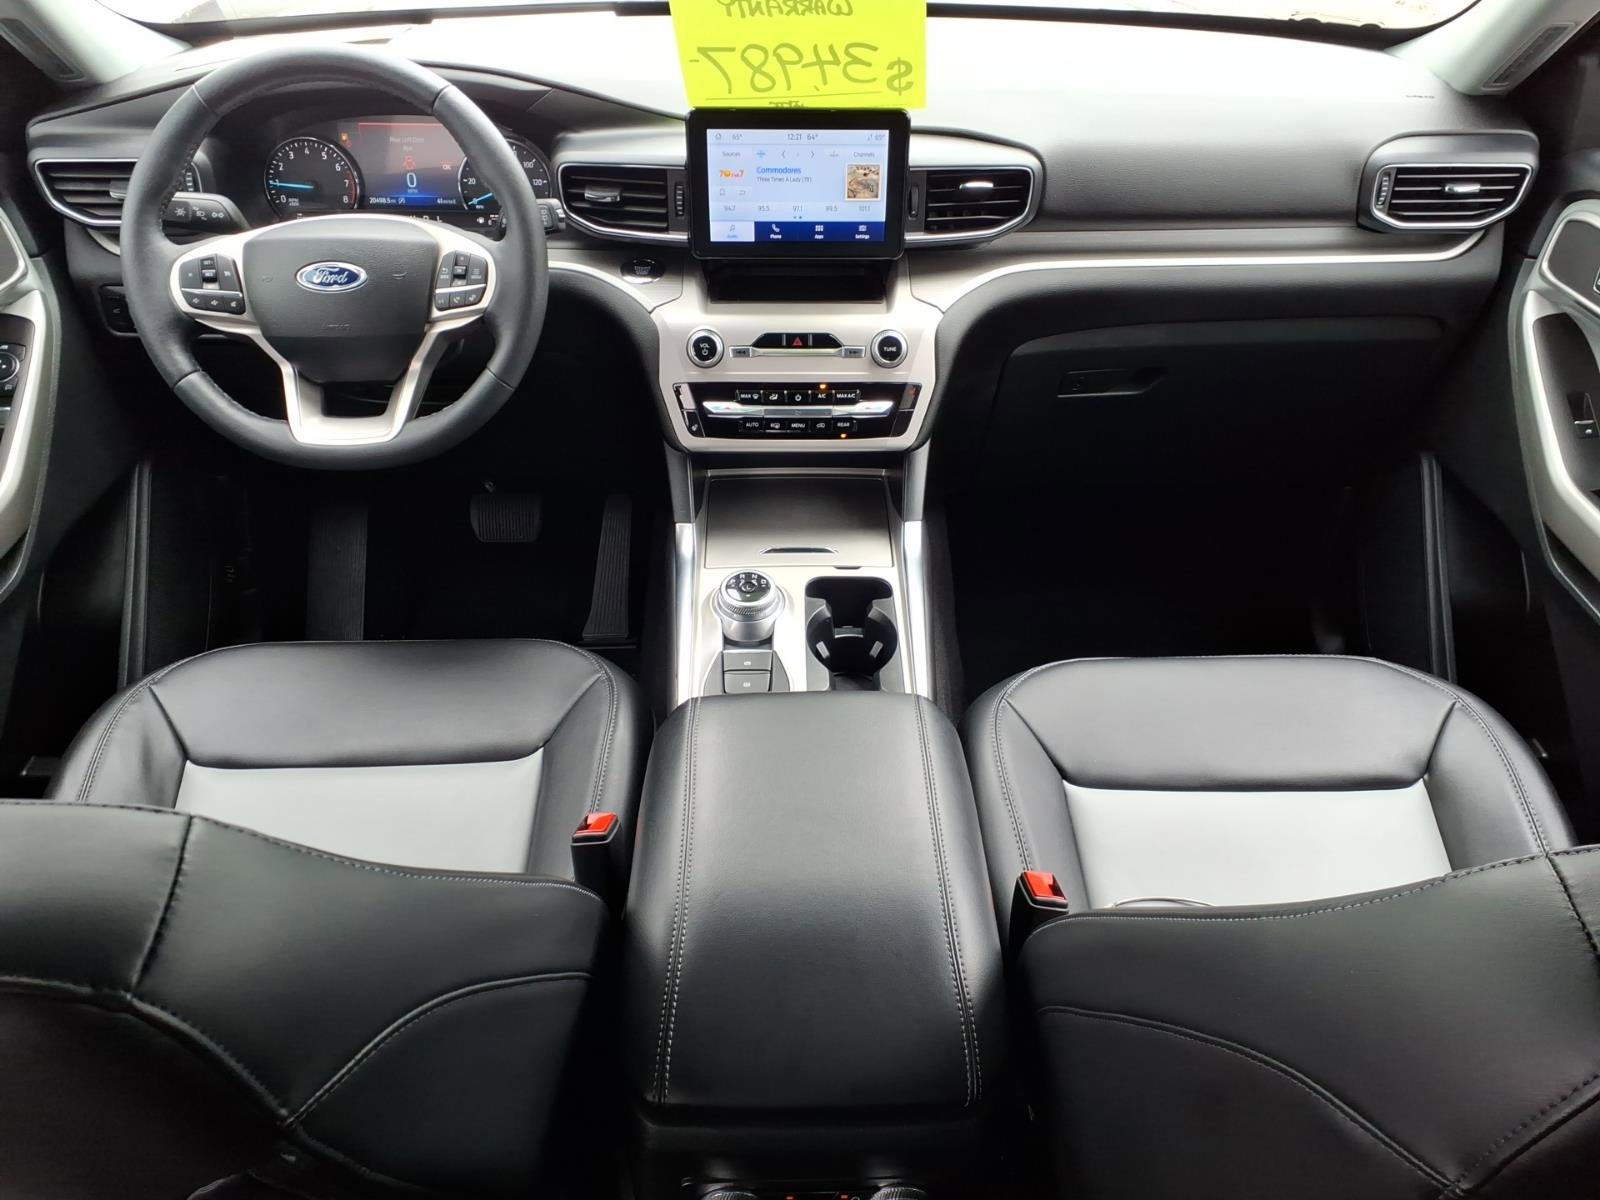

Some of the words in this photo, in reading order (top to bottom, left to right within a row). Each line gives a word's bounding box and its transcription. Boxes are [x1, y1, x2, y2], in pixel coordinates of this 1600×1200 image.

[288, 151, 294, 160] 3
[321, 152, 328, 160] 5
[278, 162, 284, 171] 2
[335, 163, 342, 171] 6
[523, 161, 534, 169] 100
[756, 166, 802, 175] Commodores
[406, 172, 417, 188] 0
[467, 177, 476, 185] 20
[281, 195, 287, 203] 0
